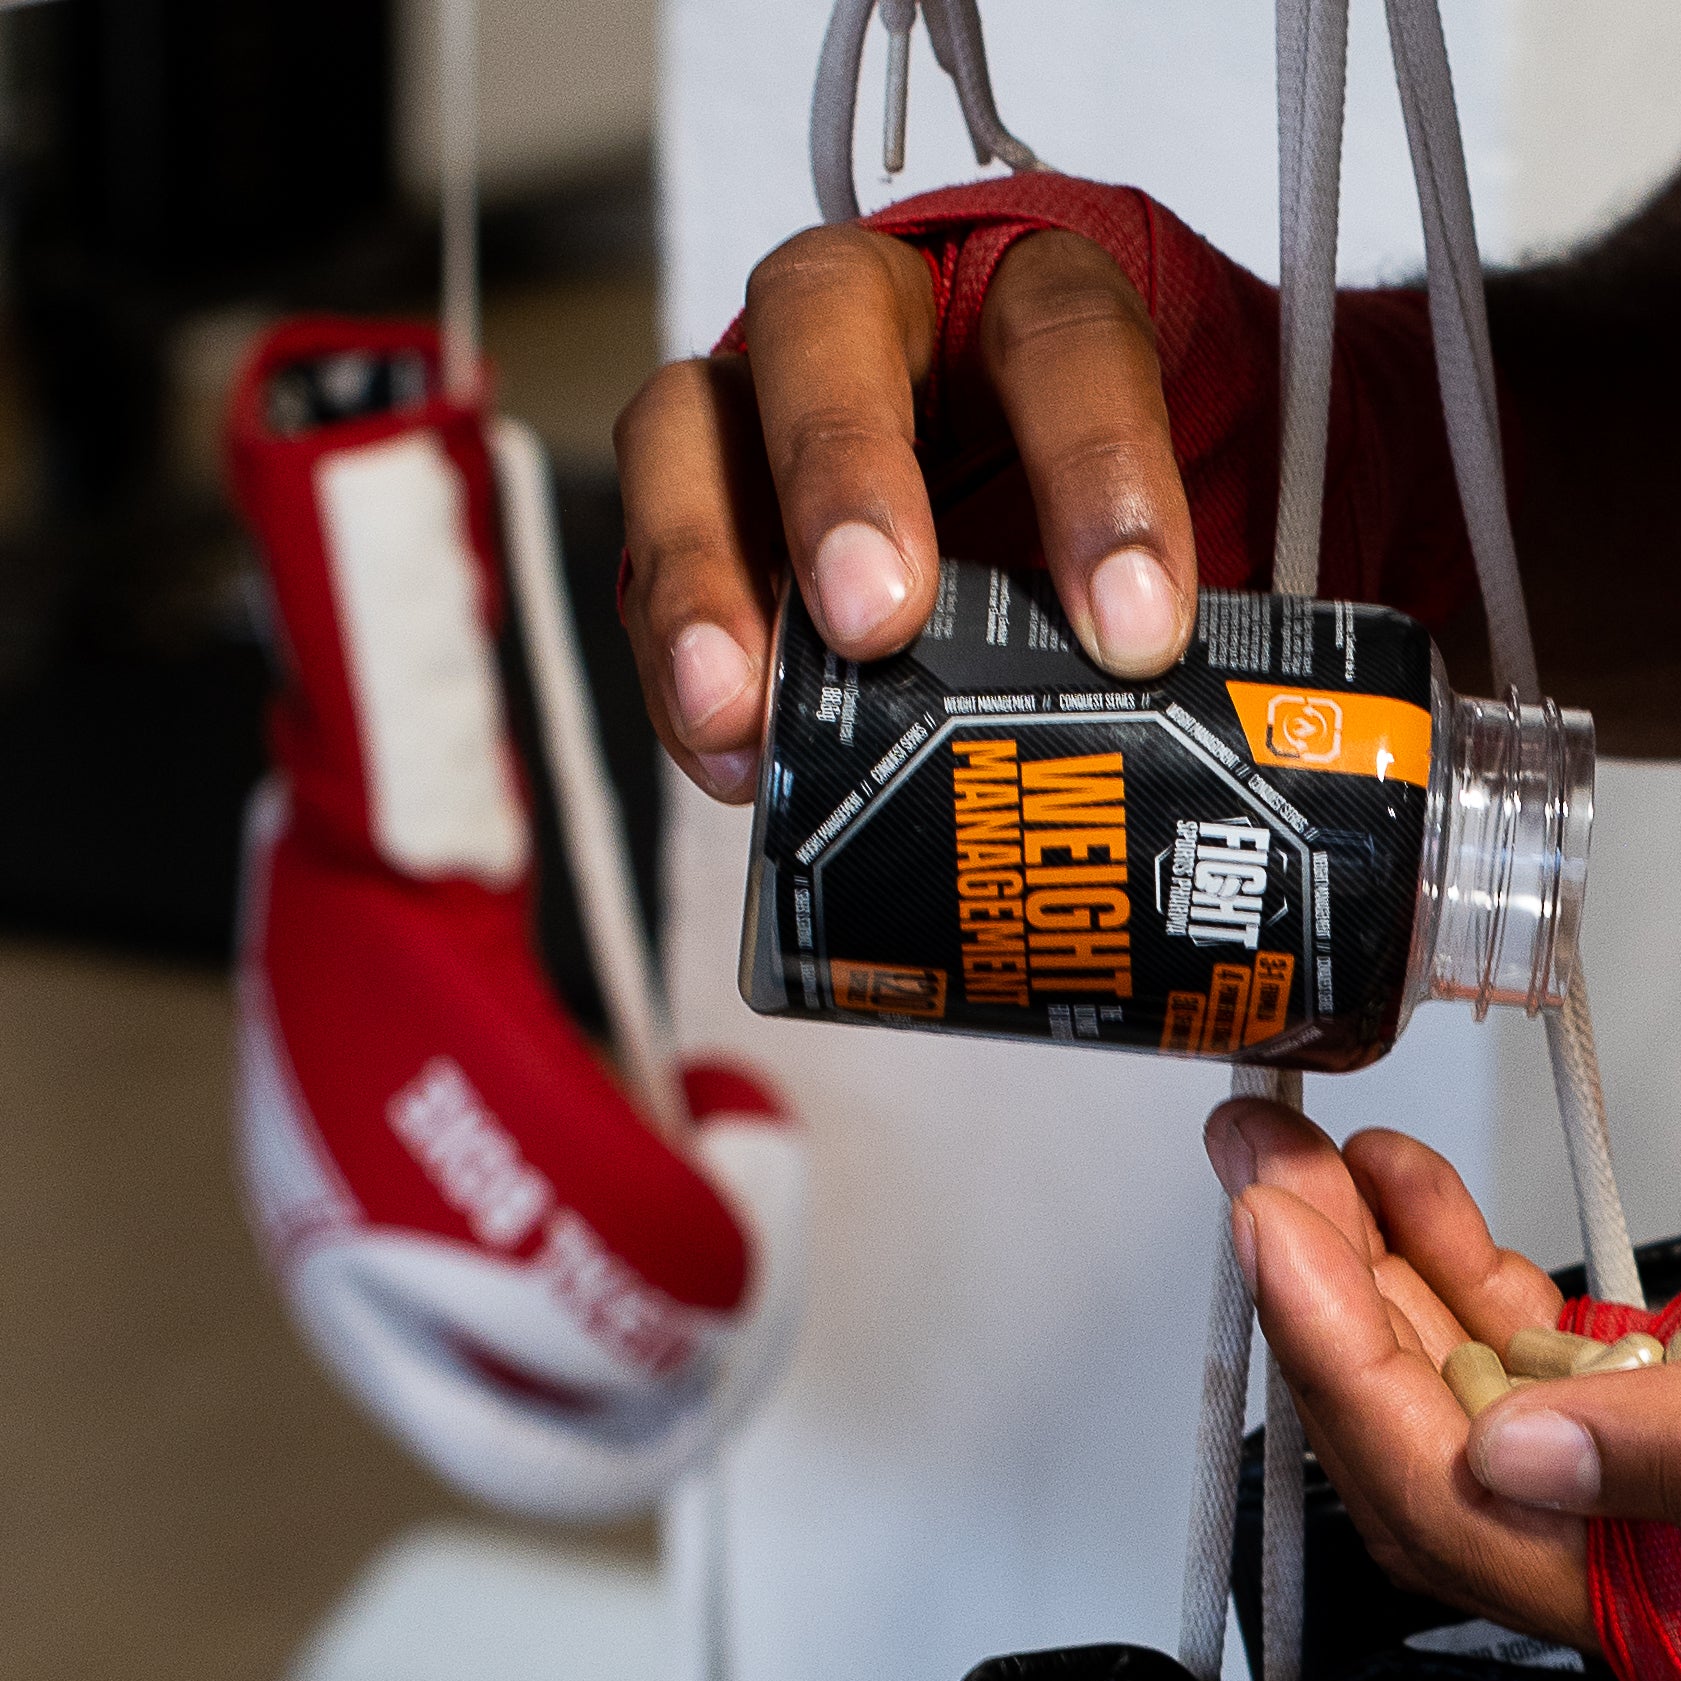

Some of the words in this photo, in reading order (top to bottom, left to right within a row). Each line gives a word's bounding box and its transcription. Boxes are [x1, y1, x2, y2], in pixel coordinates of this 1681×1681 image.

[944, 694, 976, 714] WEIGHT
[977, 694, 1036, 713] MANAGEMENT
[1059, 693, 1103, 711] CONQUEST
[1105, 692, 1135, 711] SERIES
[815, 790, 866, 843] MANAGEMENT
[869, 743, 909, 785] CONQUEST
[898, 722, 929, 754] SERIES
[1278, 802, 1310, 833] SERIES
[953, 740, 1030, 1007] MANAGEMENT
[1020, 752, 1133, 998] WEIGHT
[1172, 821, 1198, 874] SPORTS
[1188, 822, 1270, 949] FIGHT
[1166, 876, 1191, 936] PHARMA
